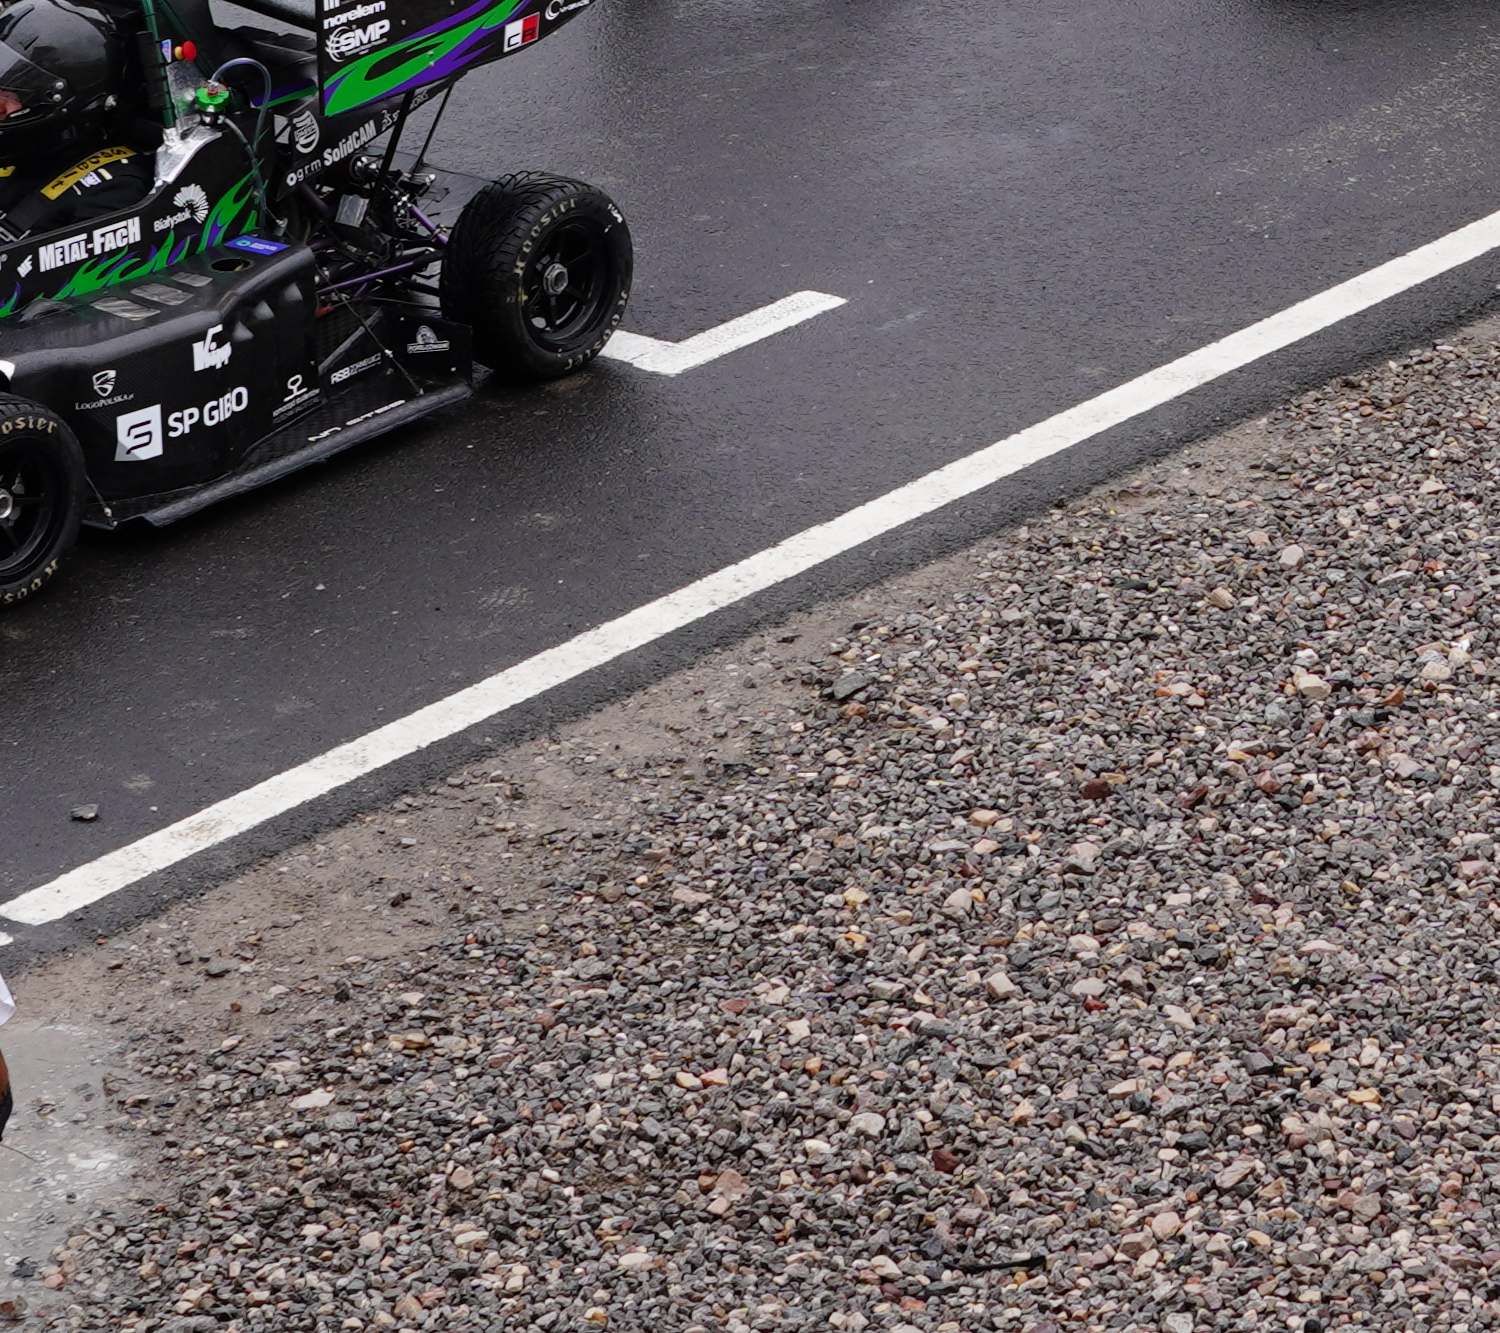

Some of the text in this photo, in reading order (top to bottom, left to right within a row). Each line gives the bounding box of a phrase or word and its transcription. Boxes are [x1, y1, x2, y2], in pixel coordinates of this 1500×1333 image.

[323, 0, 386, 30] norelem
[340, 19, 390, 53] SMP
[323, 120, 377, 167] SolidCAM
[168, 408, 199, 438] SP
[204, 386, 249, 428] GIBO
